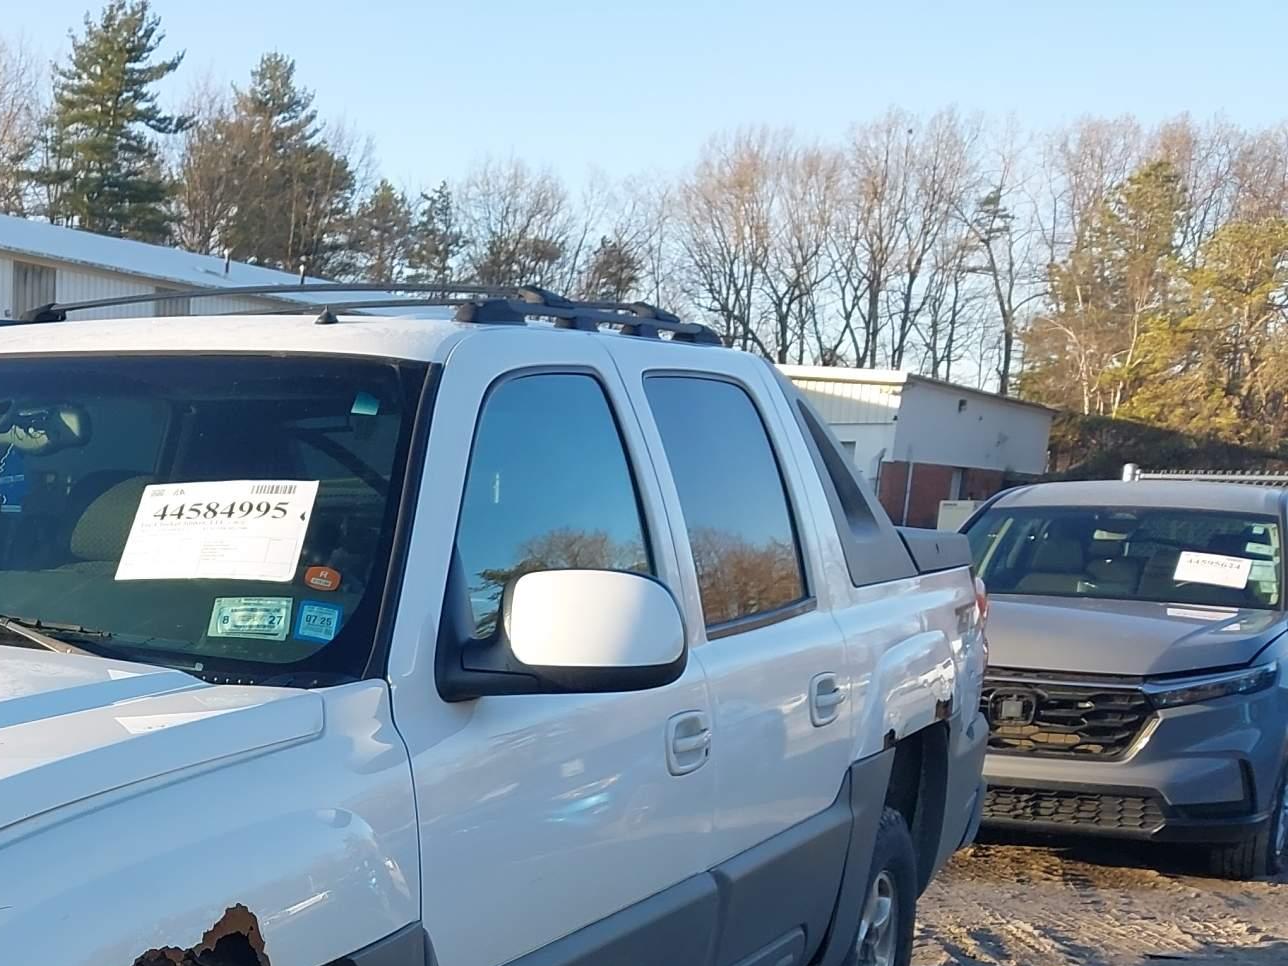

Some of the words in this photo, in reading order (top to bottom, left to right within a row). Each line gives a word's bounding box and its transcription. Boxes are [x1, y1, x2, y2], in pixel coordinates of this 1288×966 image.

[153, 501, 290, 521] 44584995
[222, 615, 230, 625] 8
[268, 615, 283, 626] 27
[305, 614, 318, 624] 07
[320, 617, 332, 626] 25
